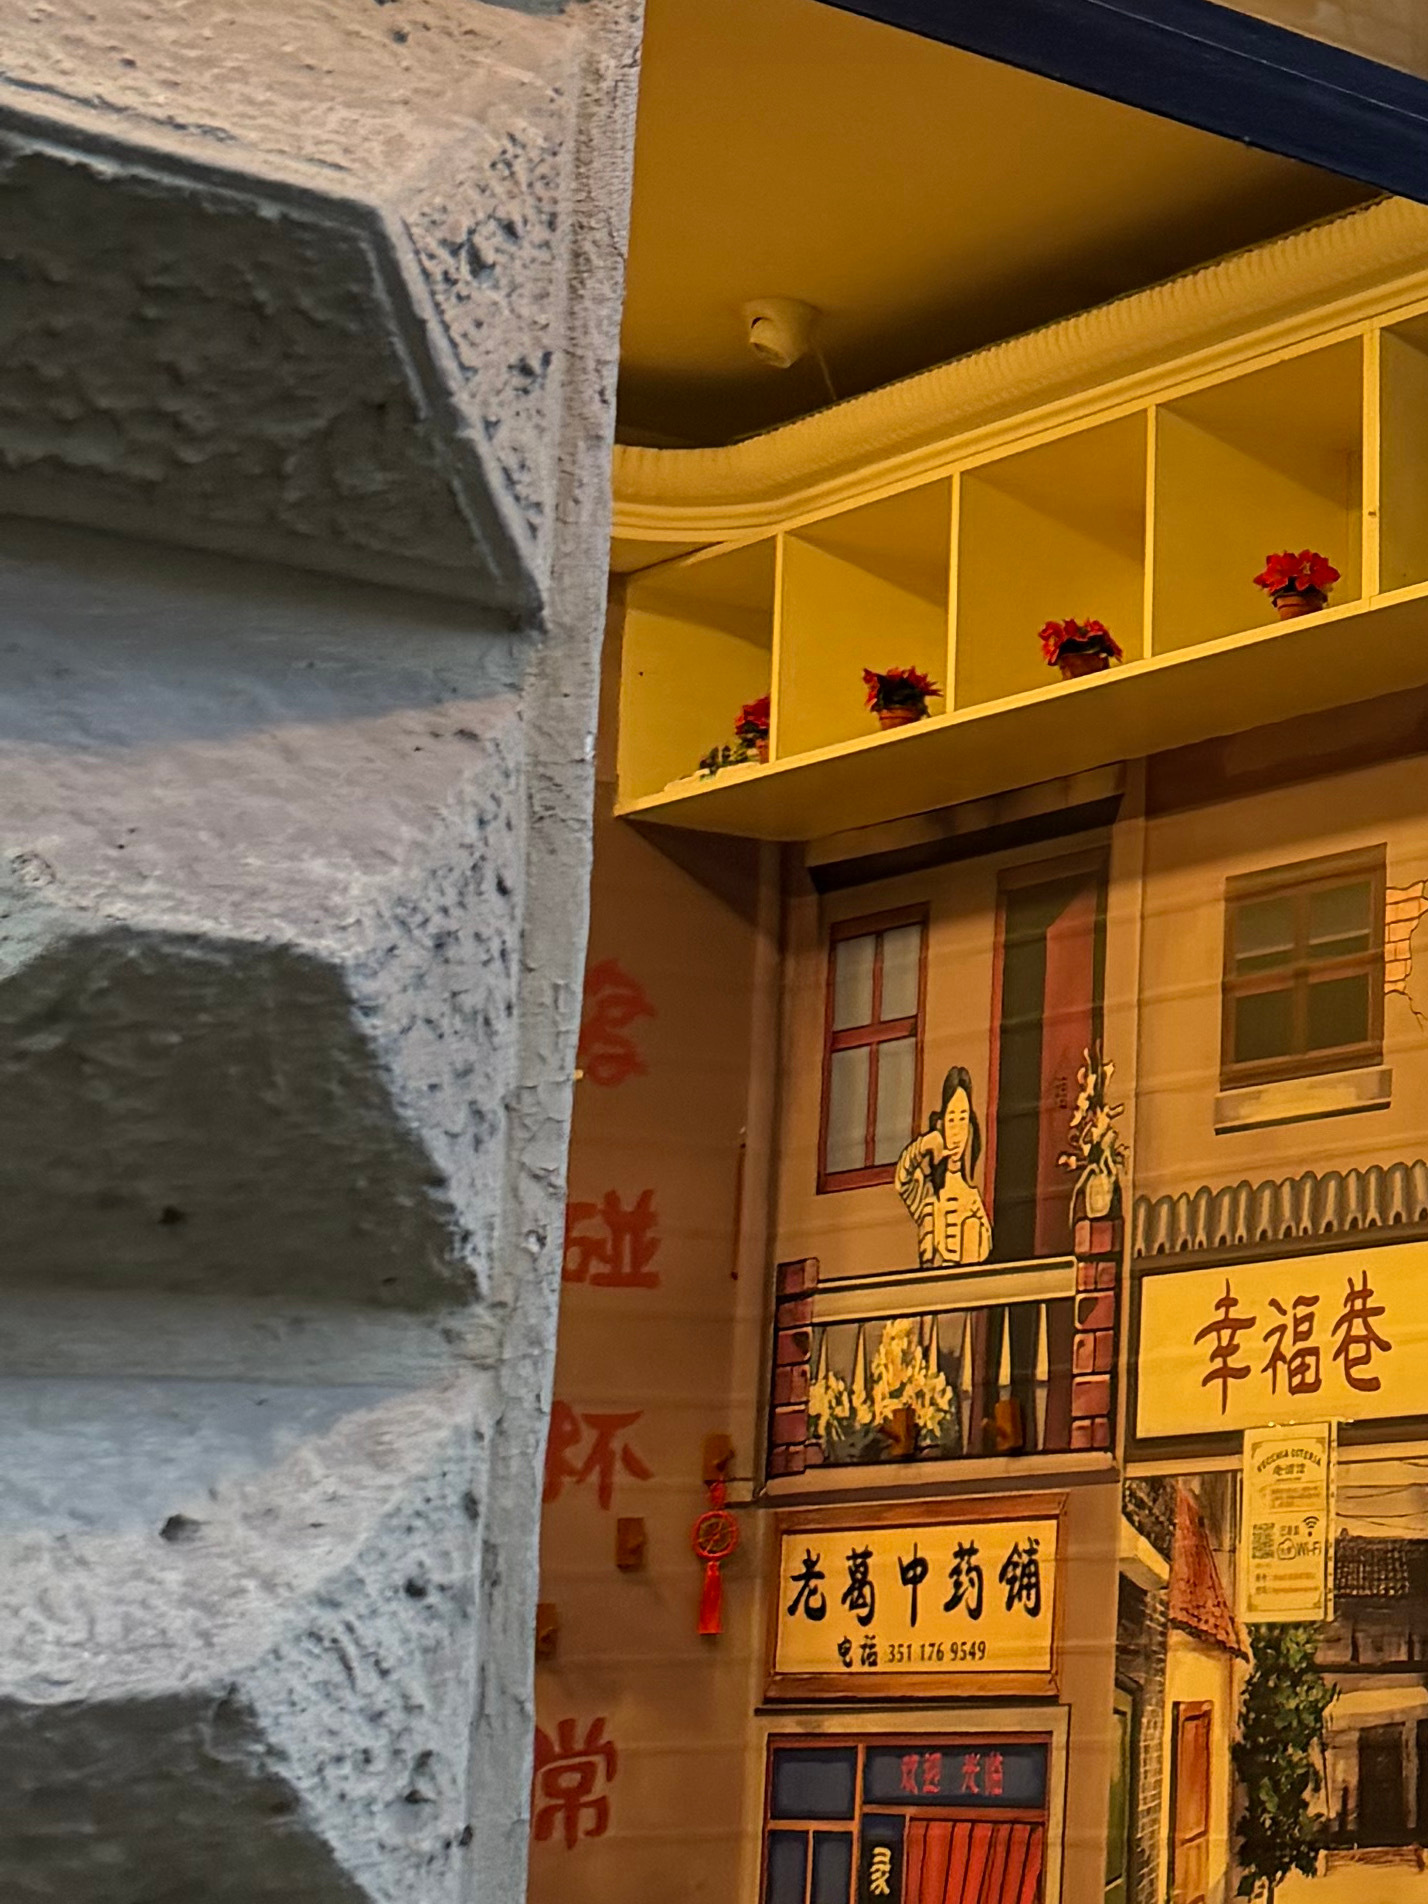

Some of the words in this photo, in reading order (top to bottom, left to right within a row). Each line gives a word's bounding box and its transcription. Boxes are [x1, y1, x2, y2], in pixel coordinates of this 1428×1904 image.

[1194, 1270, 1392, 1416] 幸福巷
[788, 1537, 1042, 1628] 老葛中药铺
[837, 1635, 879, 1668] 电话
[887, 1642, 914, 1663] 351
[919, 1642, 945, 1663] 176
[950, 1640, 987, 1662] 9549
